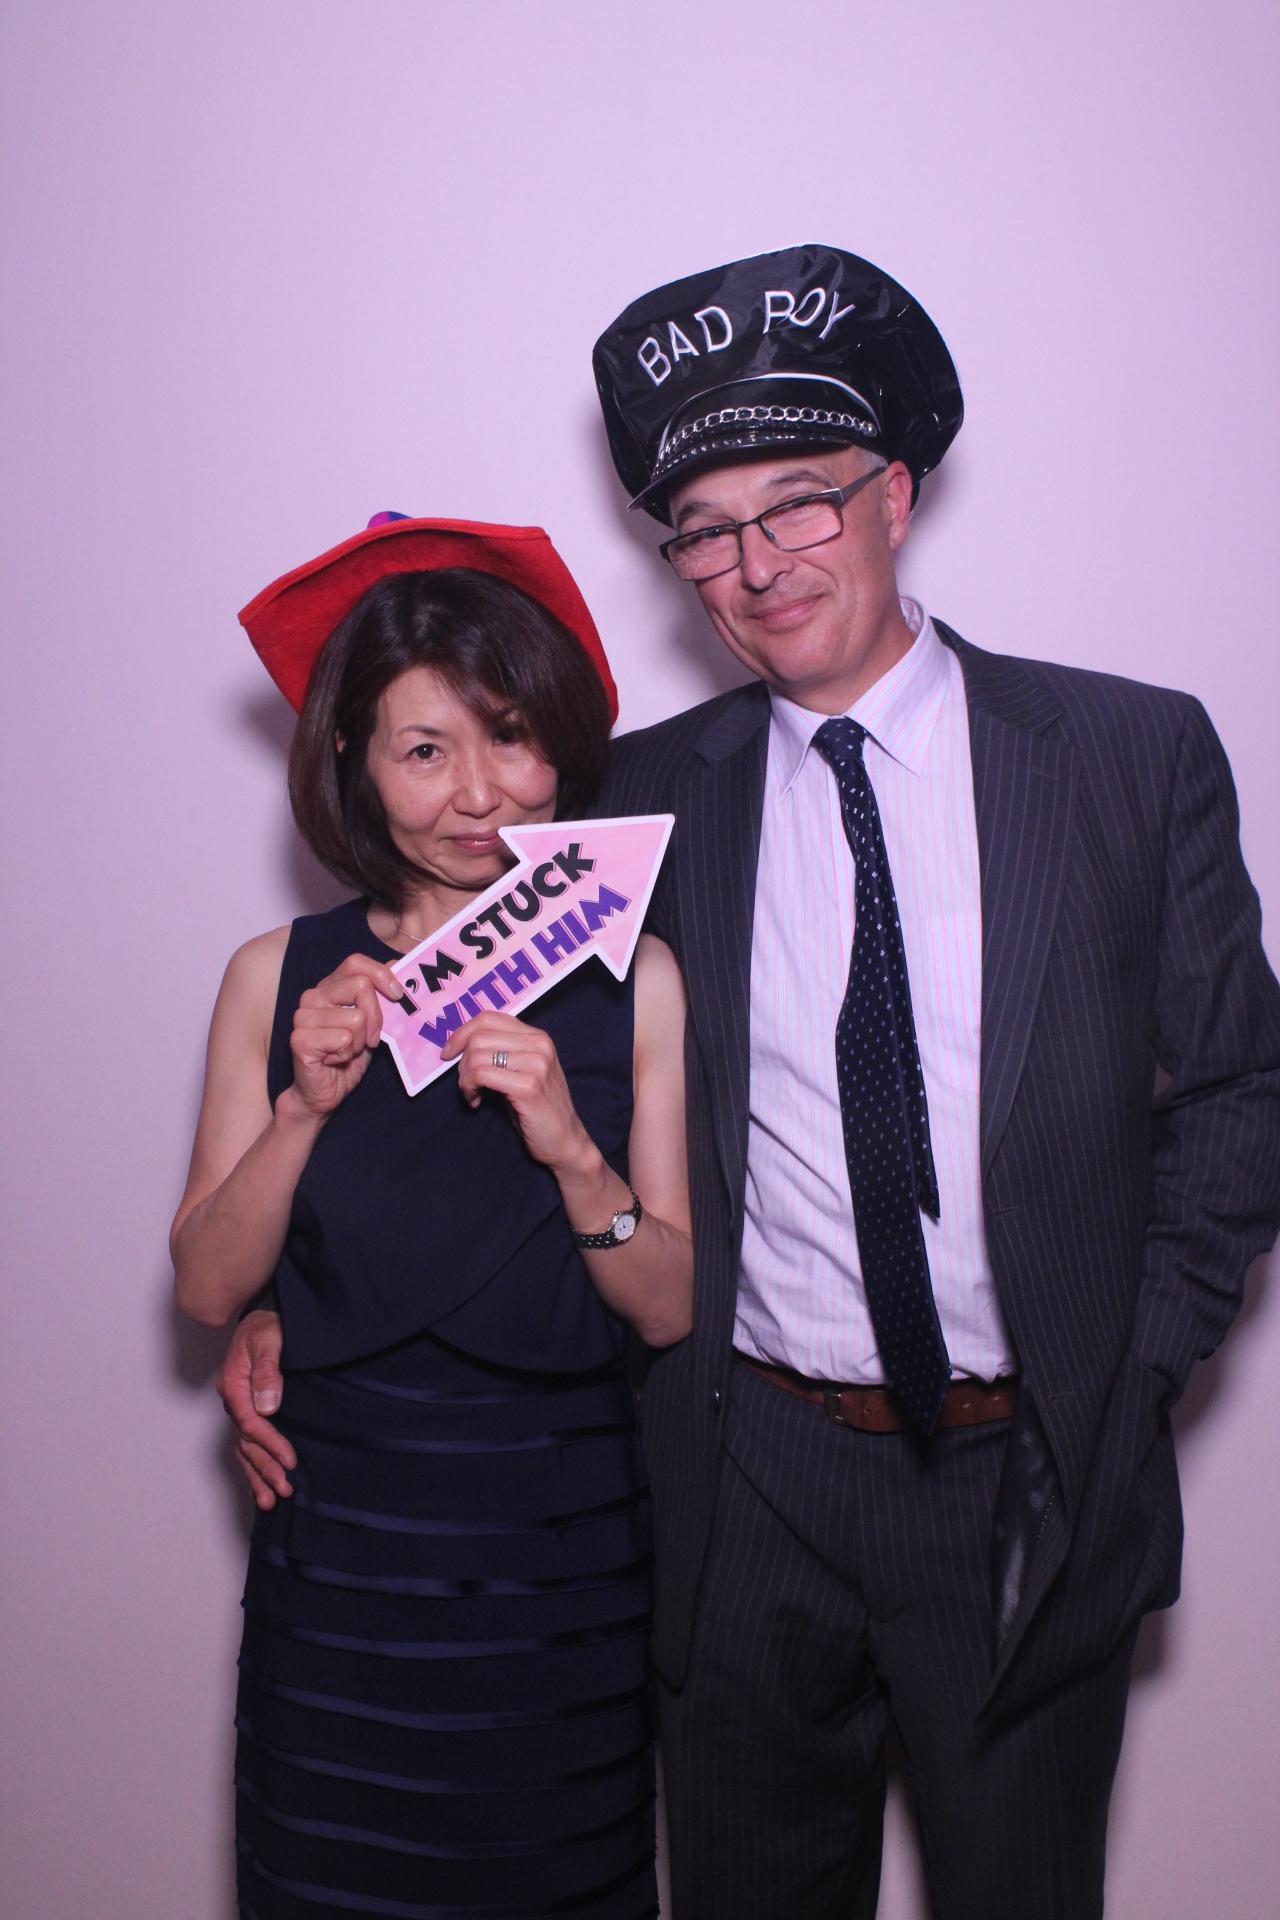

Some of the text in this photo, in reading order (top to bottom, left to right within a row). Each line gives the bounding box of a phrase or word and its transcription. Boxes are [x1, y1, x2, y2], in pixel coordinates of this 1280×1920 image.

[637, 305, 733, 387] BAD
[458, 842, 597, 960] STUCK
[418, 883, 632, 1050] WITH HIM
